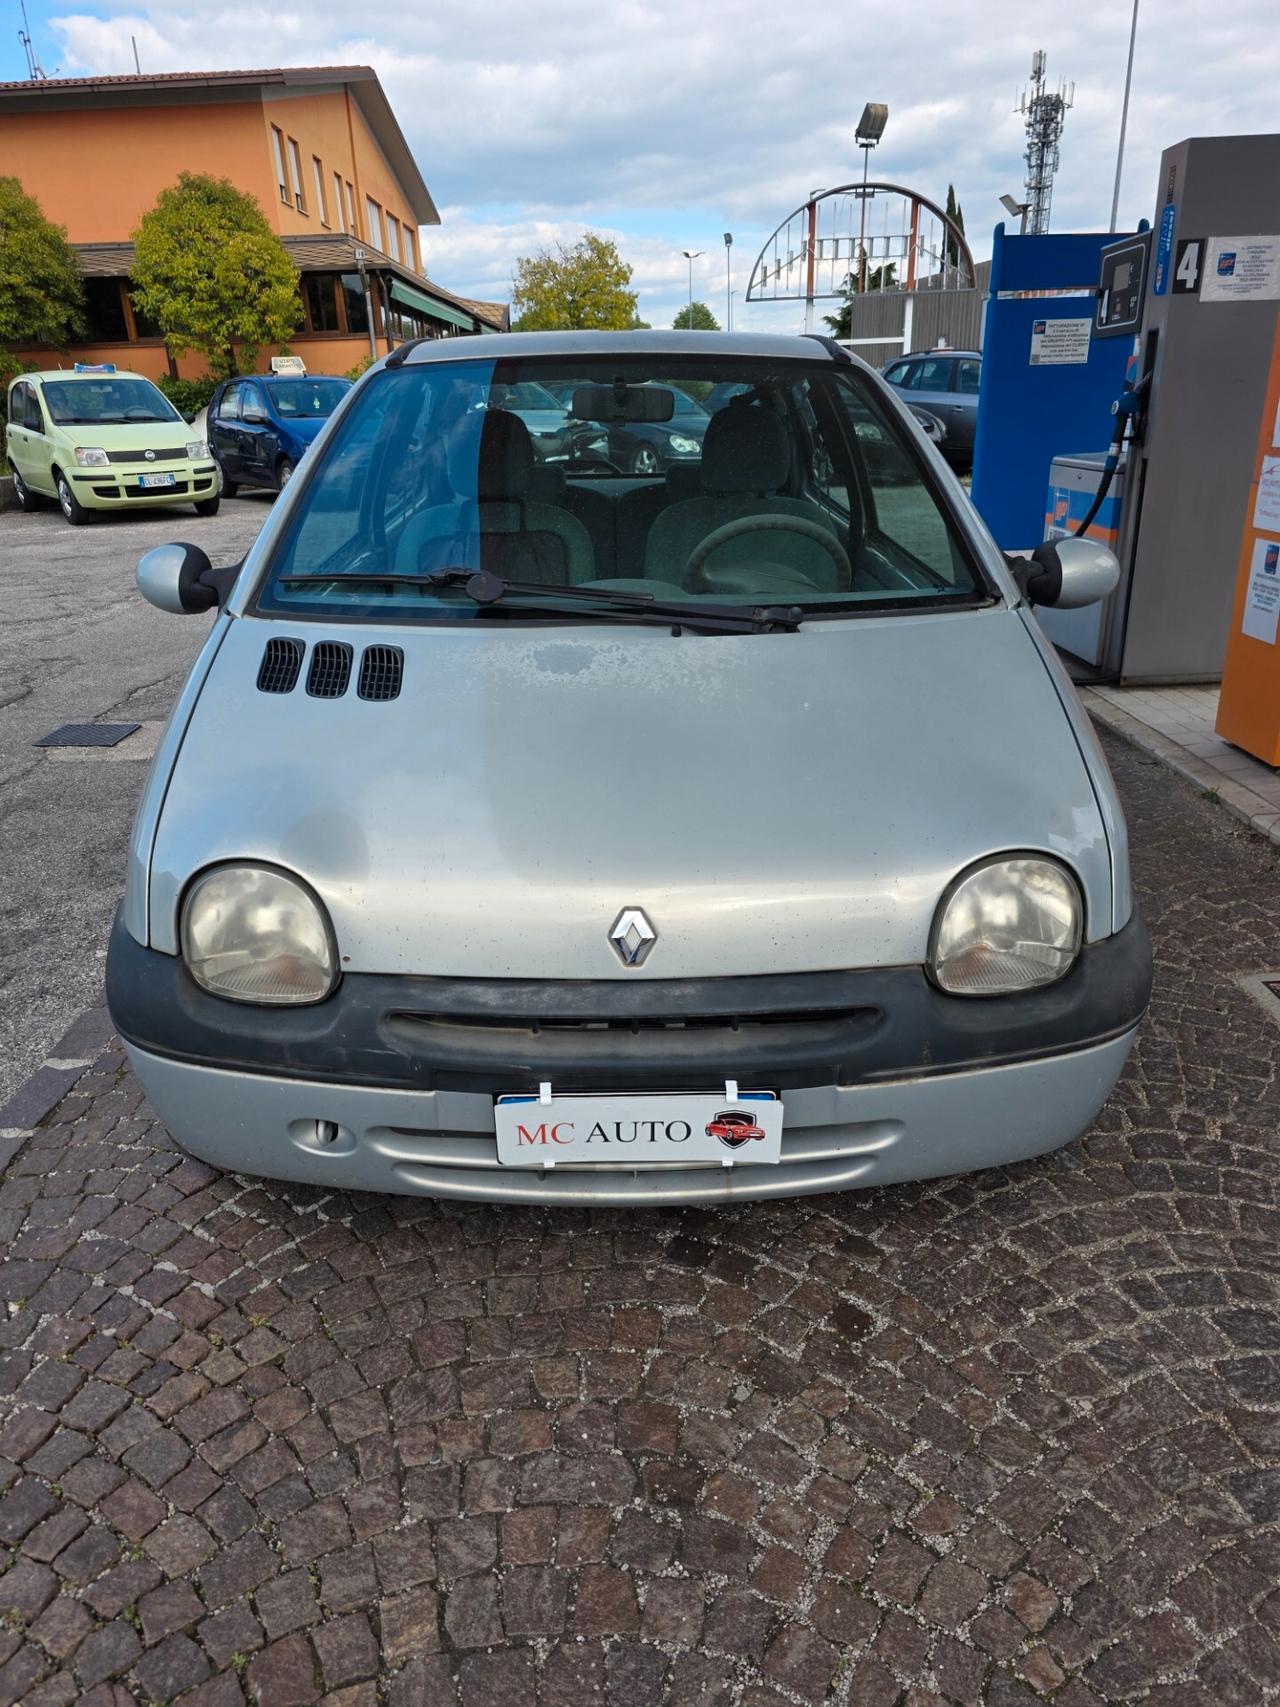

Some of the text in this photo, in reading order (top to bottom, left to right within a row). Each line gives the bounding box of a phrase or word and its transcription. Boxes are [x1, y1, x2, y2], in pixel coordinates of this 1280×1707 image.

[1176, 242, 1200, 289] 4
[516, 1120, 693, 1146] MC AUTO
